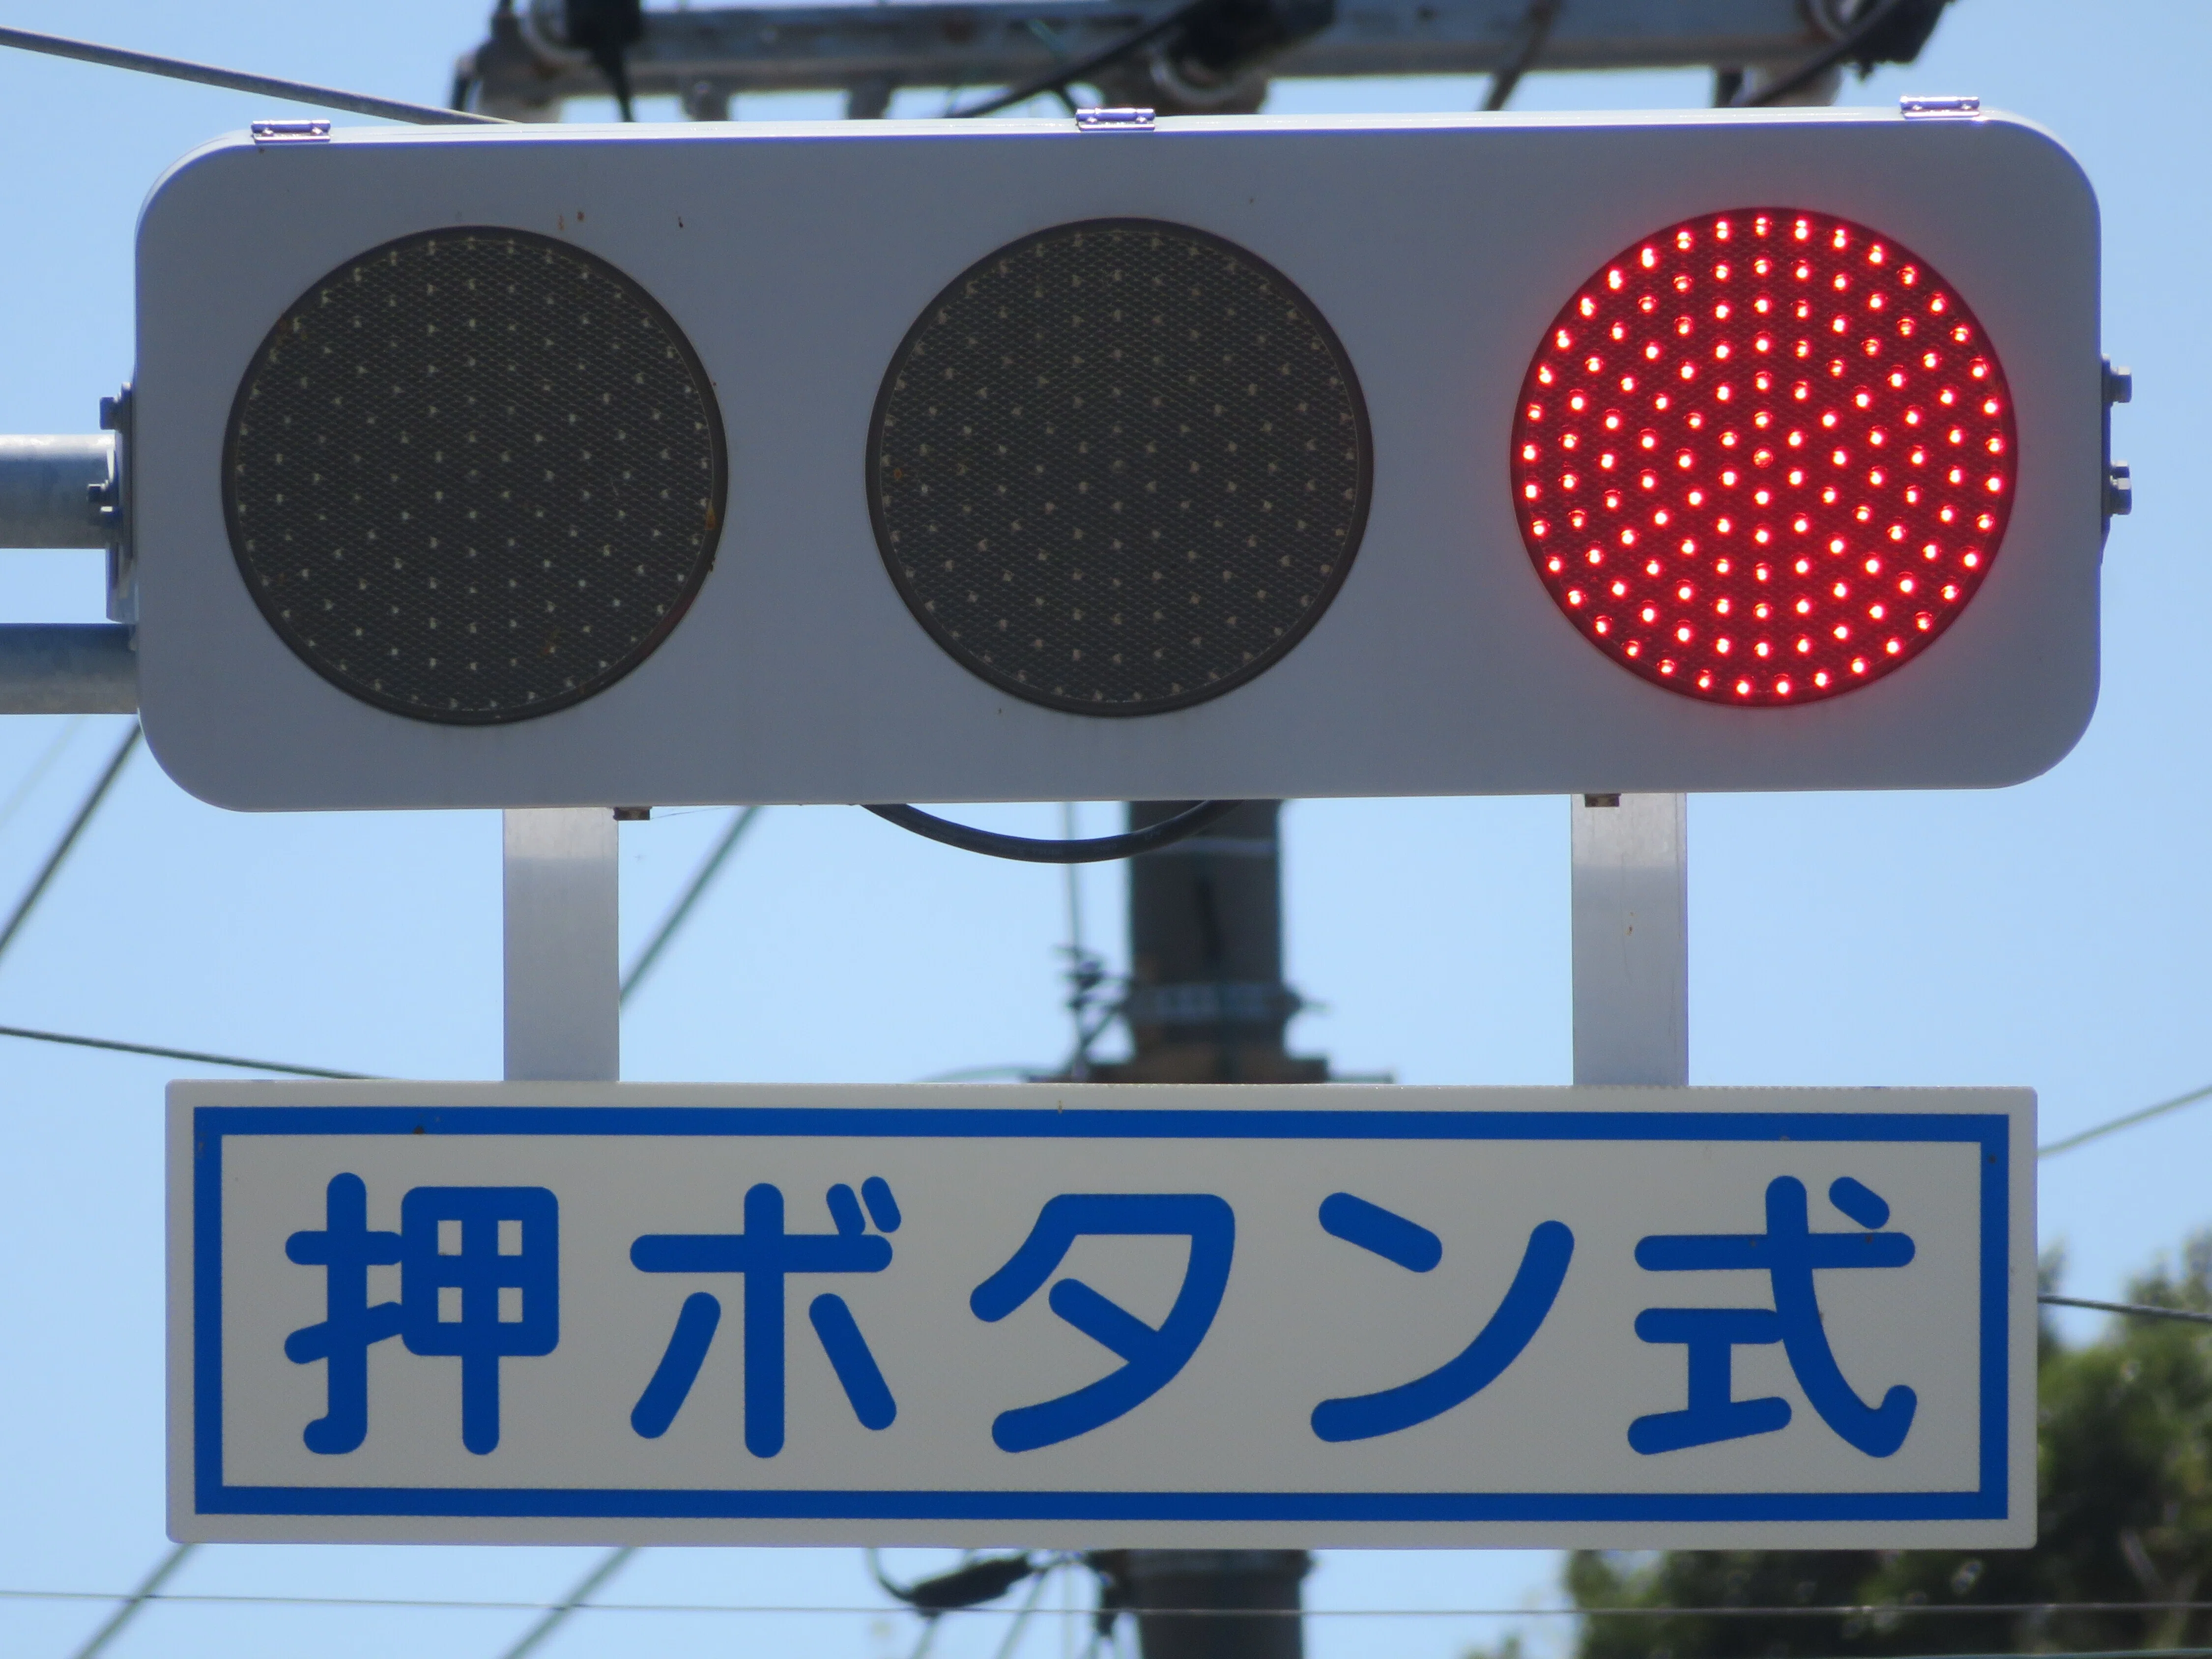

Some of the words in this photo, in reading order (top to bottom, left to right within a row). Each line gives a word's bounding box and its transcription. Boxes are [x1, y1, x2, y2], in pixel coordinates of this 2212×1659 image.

[284, 1172, 1918, 1459] 押ボタン式
